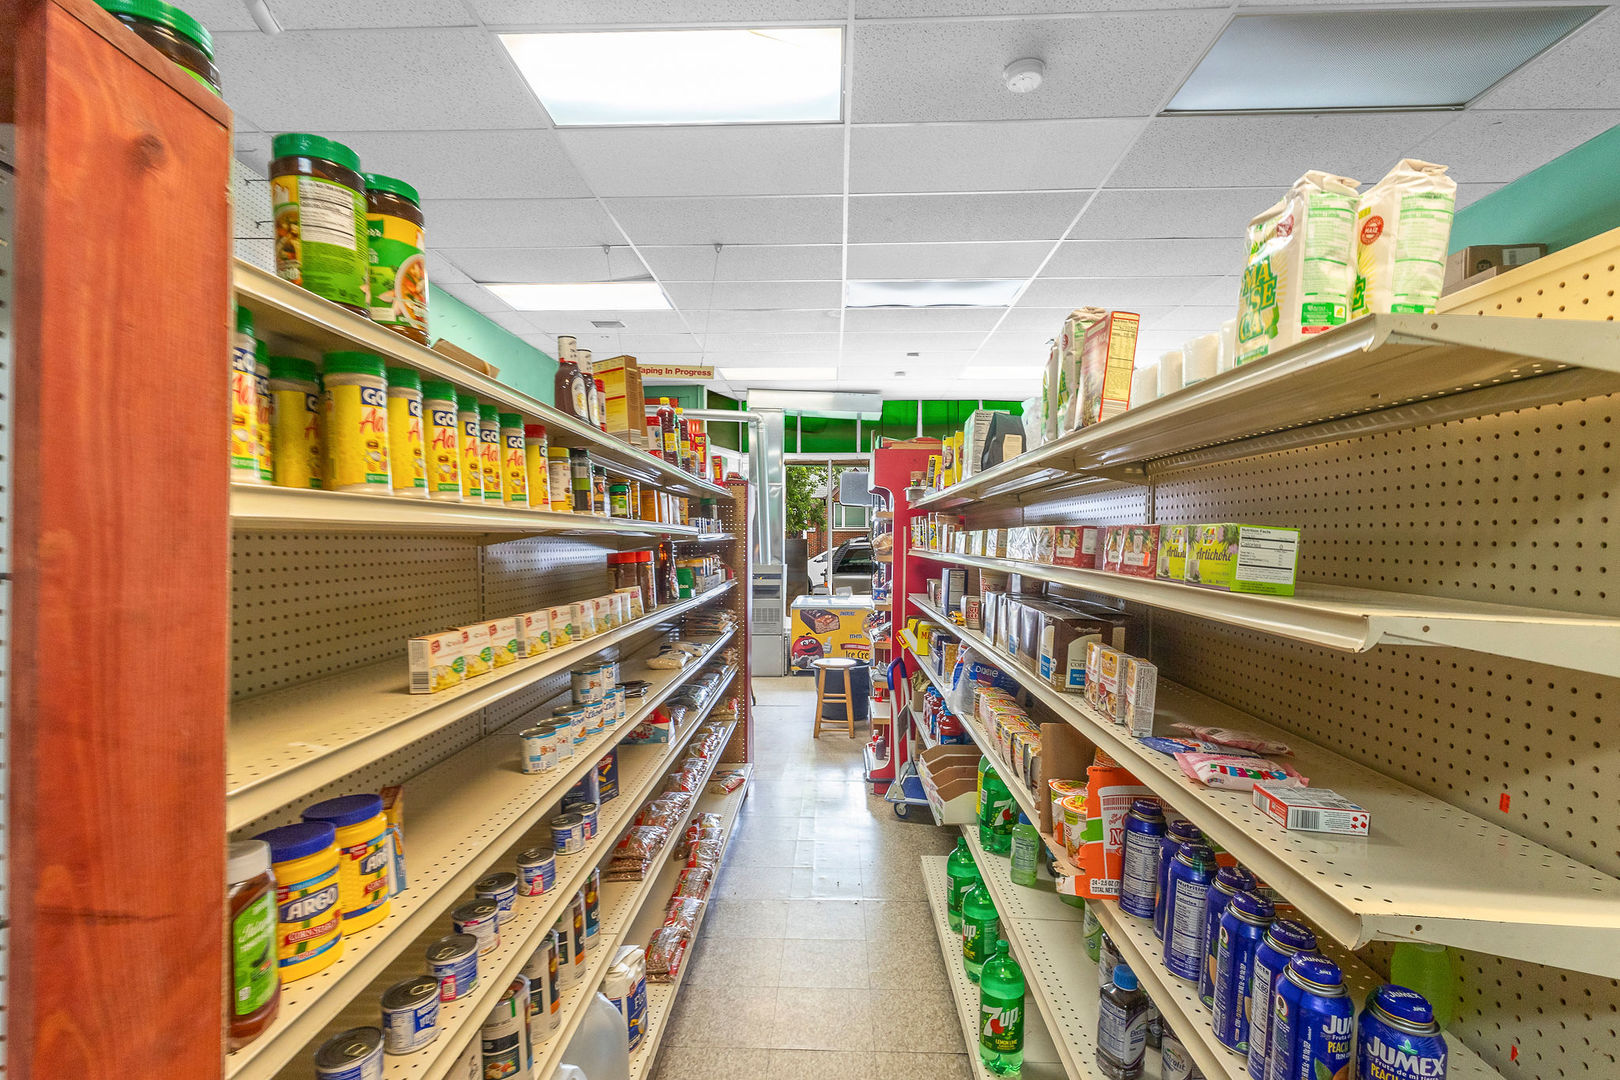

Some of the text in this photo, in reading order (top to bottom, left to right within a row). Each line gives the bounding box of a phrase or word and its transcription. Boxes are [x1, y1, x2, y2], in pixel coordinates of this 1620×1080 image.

[674, 368, 712, 377] Progress
[1196, 547, 1232, 562] Artichoke
[286, 887, 336, 921] ARGO
[1366, 1037, 1445, 1077] JUMEX
[1375, 1059, 1397, 1072] Fruta
